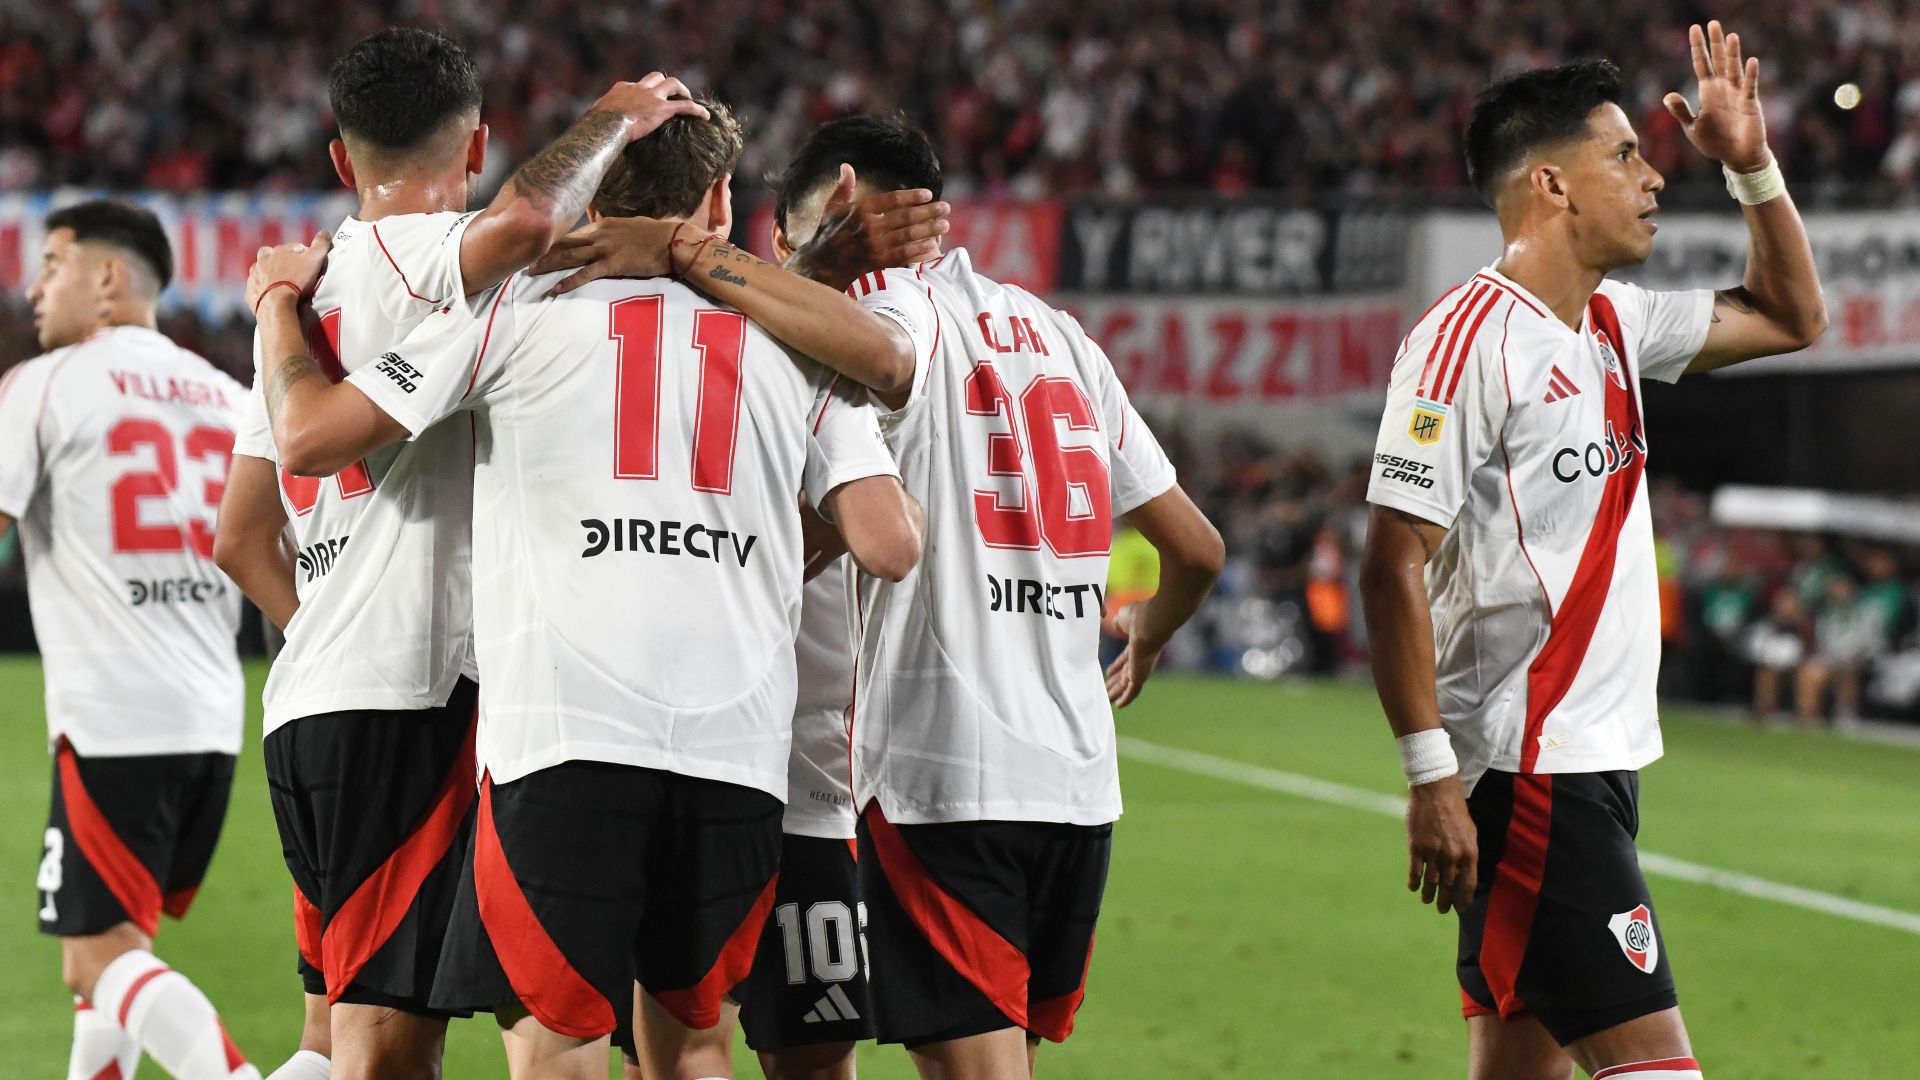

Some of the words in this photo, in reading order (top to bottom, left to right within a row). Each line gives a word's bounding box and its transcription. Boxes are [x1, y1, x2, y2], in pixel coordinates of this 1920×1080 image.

[608, 294, 747, 496] 11
[107, 417, 235, 561] 23
[963, 359, 1112, 560] 36
[1375, 453, 1434, 475] ASSIST
[1381, 467, 1435, 490] CARD
[580, 518, 758, 568] DIRECTV
